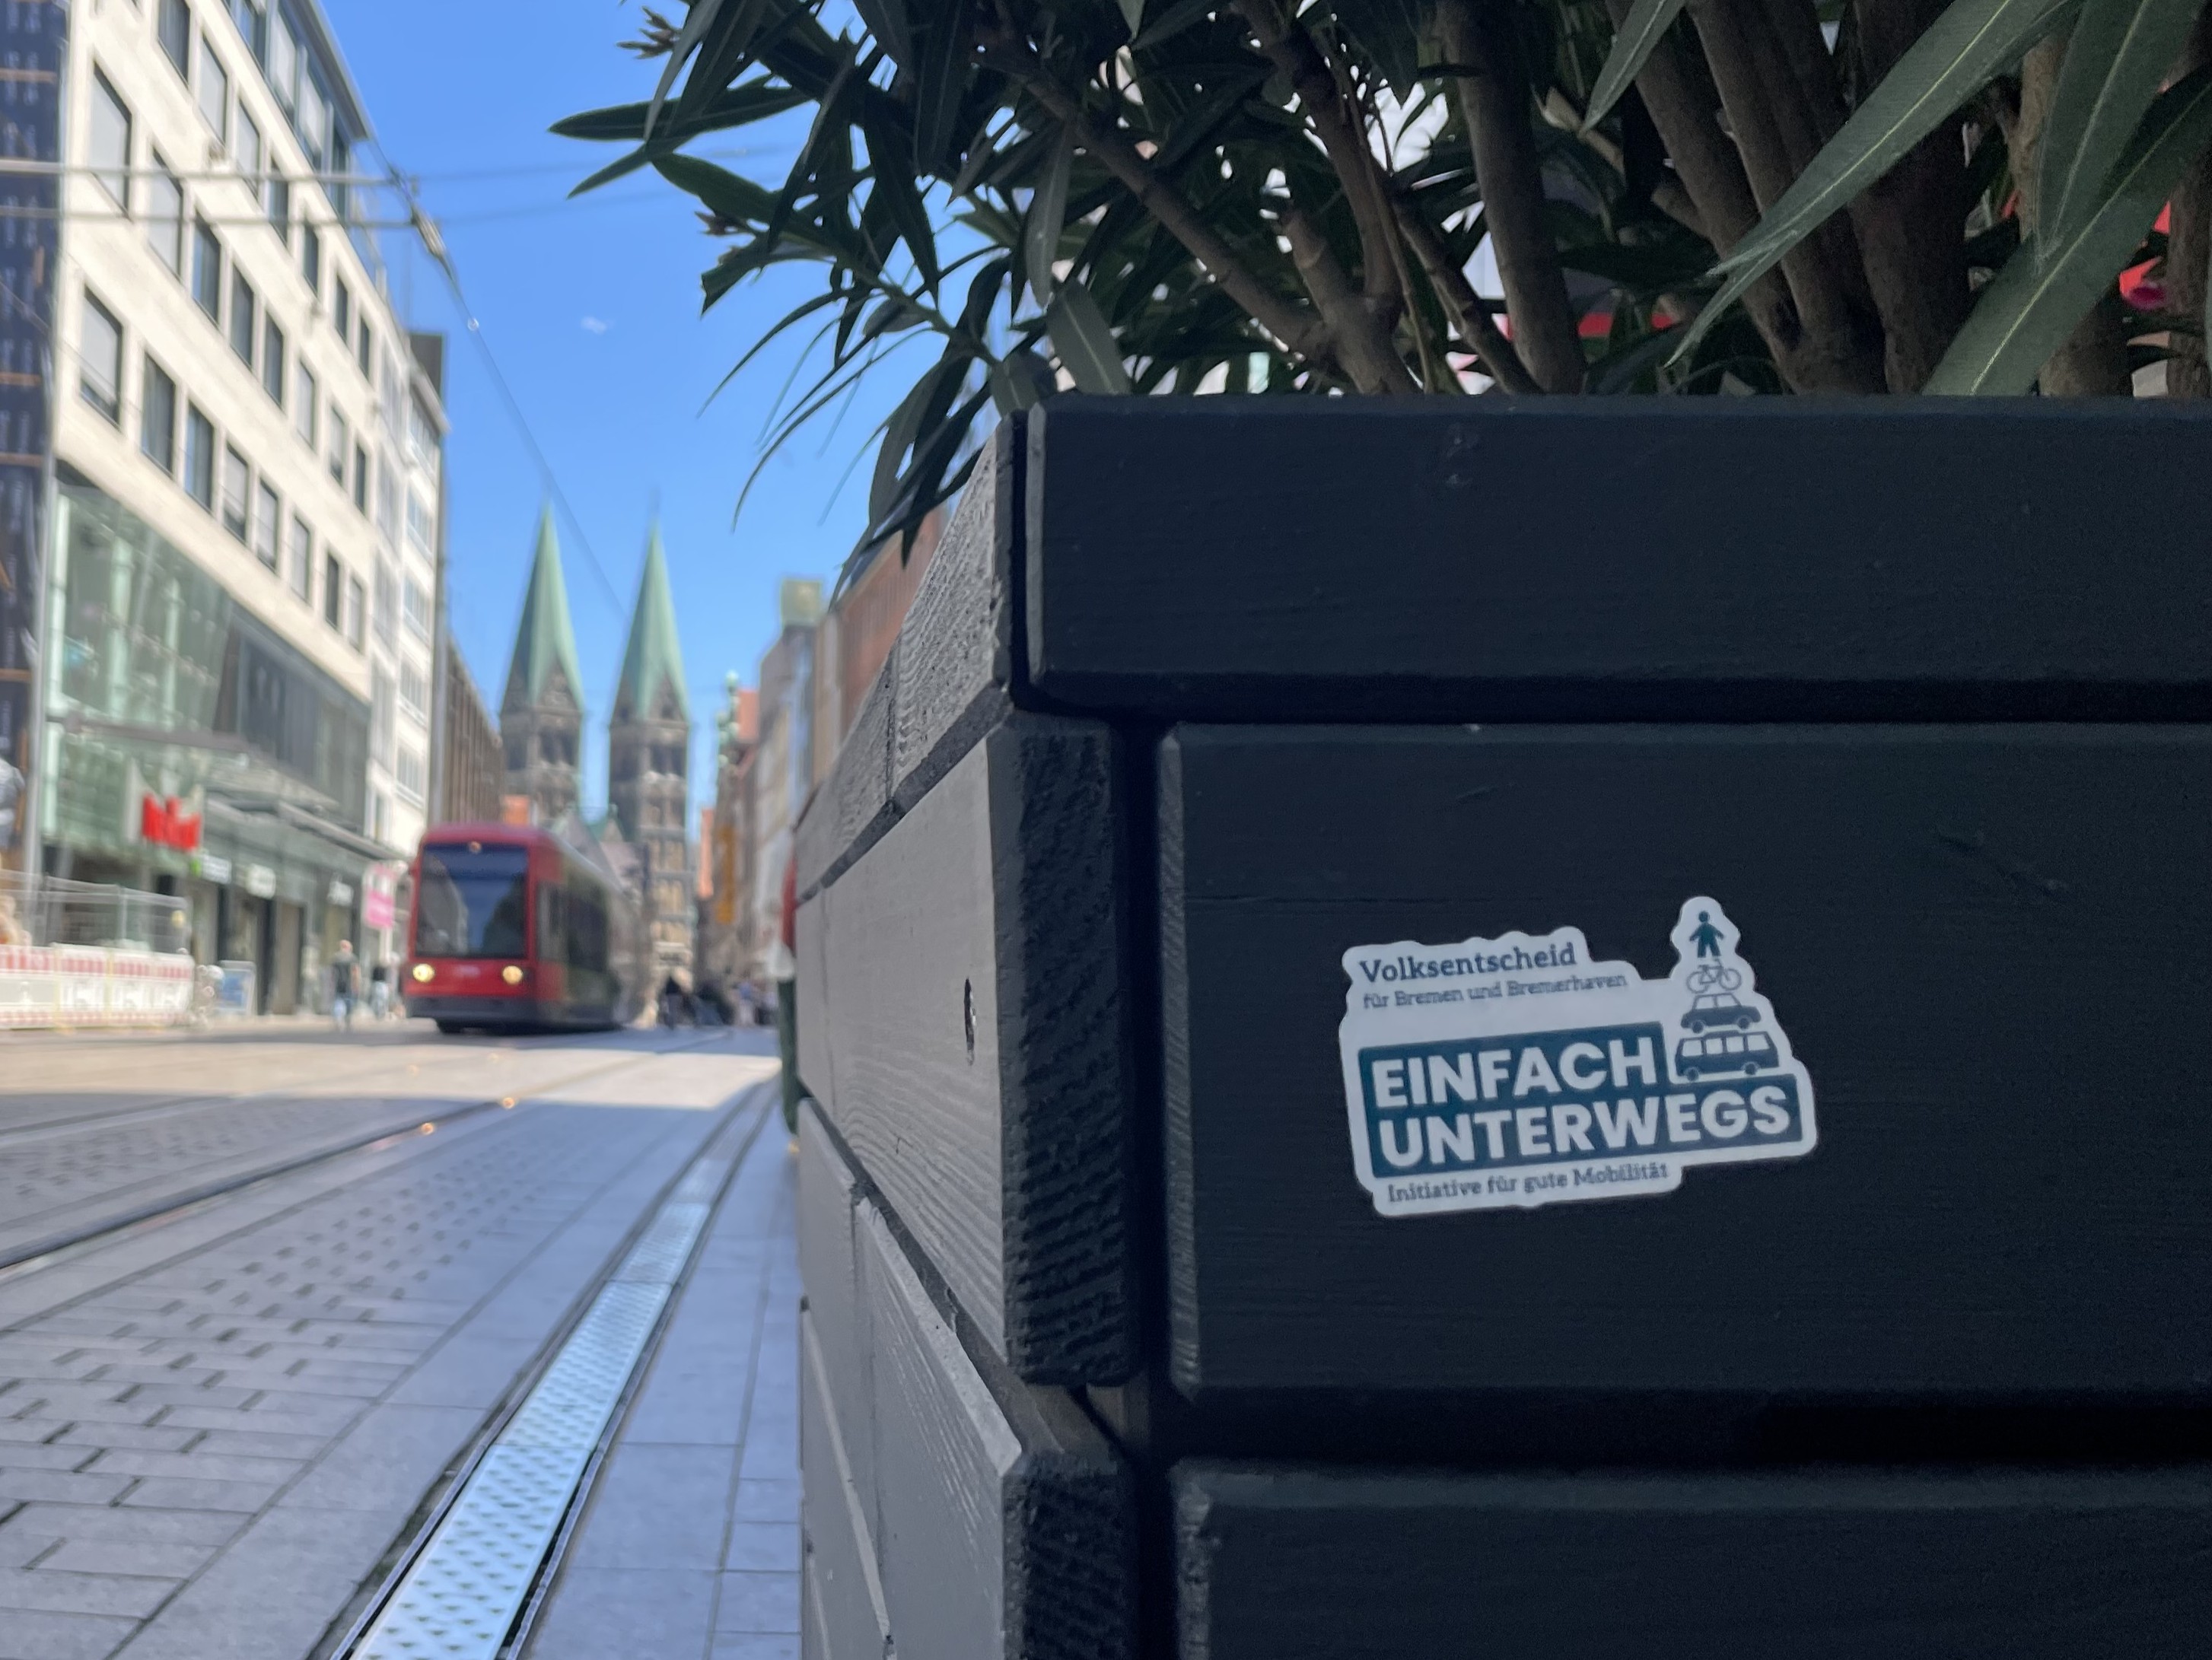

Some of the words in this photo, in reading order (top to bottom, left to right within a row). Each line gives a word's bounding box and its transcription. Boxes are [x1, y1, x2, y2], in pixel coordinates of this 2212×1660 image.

[1360, 942, 1577, 983] Volksentscheid
[1363, 991, 1389, 1009] für
[1394, 990, 1464, 1006] Bremen
[1466, 981, 1504, 1000] und
[1507, 974, 1628, 997] Bremerhaven
[1372, 1036, 1658, 1108] EINFACH
[1379, 1086, 1791, 1168] UNTERWEGS
[1388, 1178, 1482, 1203] Initiative
[1487, 1175, 1520, 1194] für
[1524, 1172, 1568, 1194] gute
[1572, 1161, 1669, 1187] Mobilität
